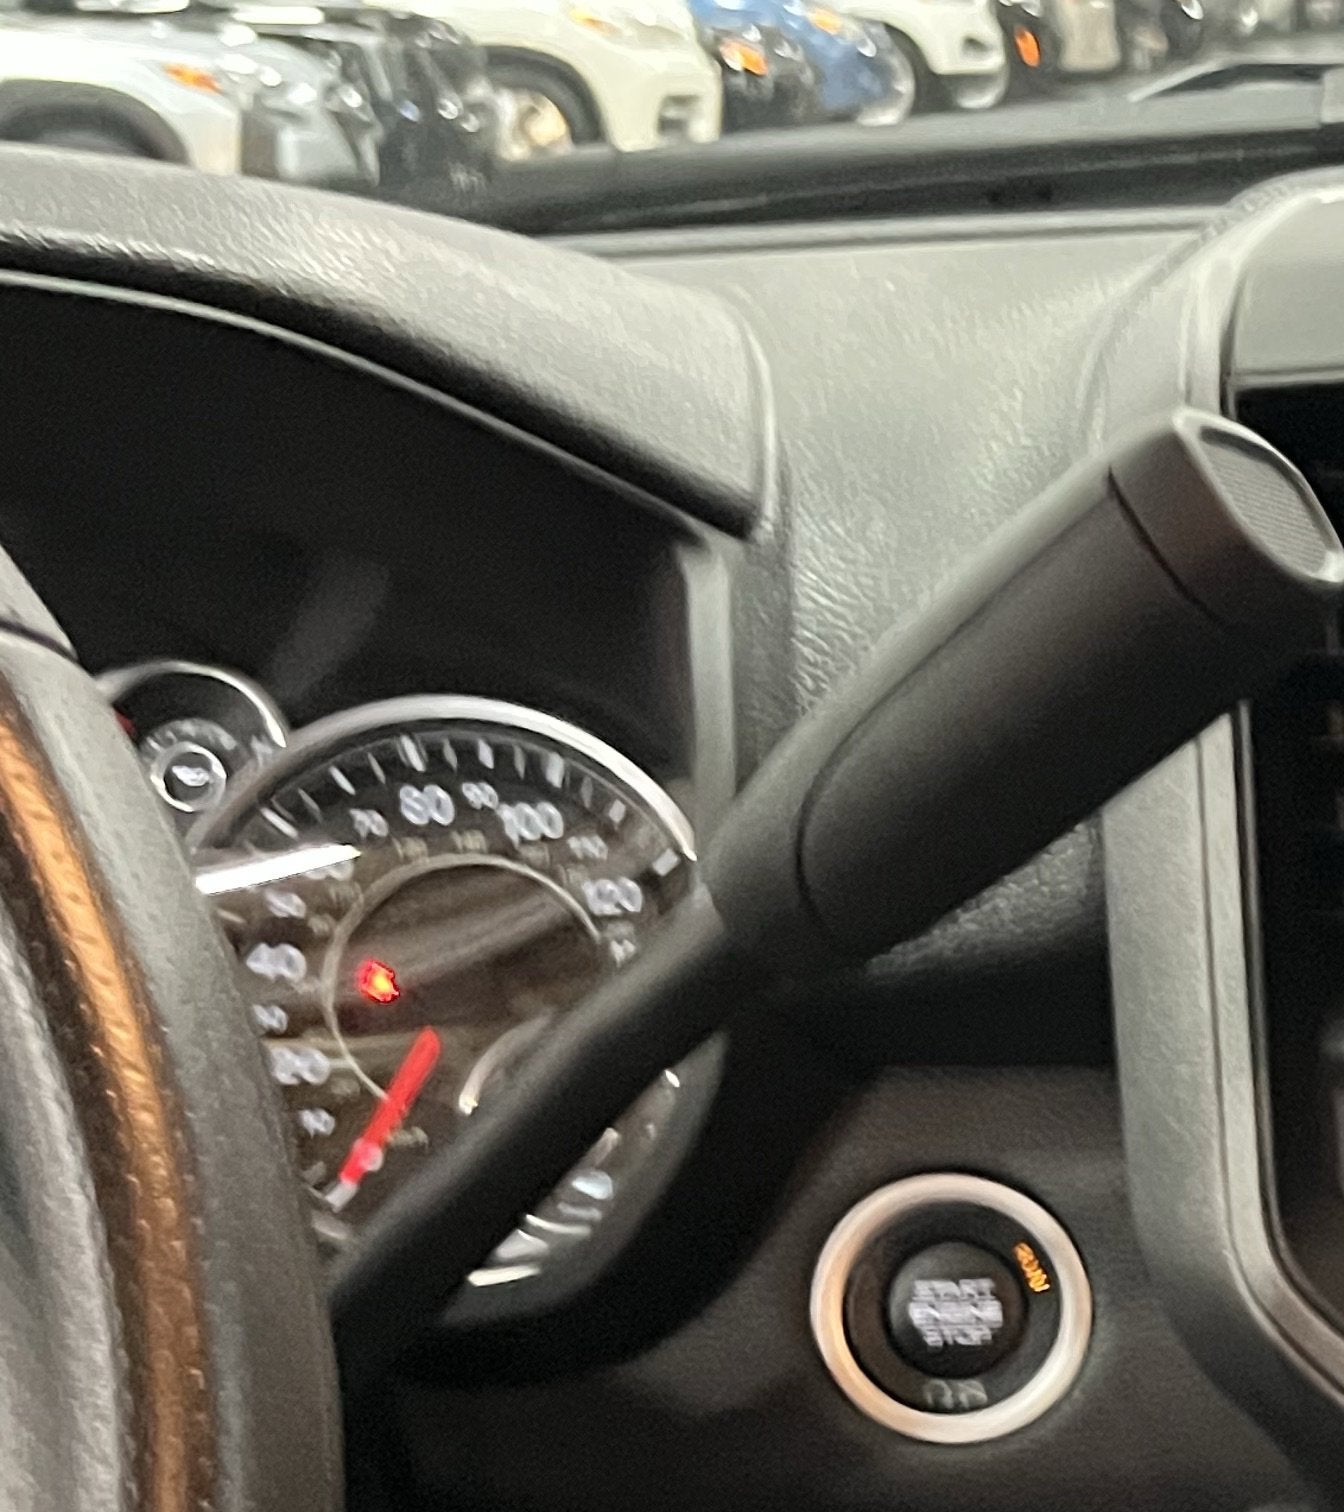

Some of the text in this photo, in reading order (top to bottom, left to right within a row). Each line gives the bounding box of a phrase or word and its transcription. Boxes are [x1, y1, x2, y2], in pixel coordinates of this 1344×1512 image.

[400, 784, 455, 826] 80
[500, 801, 564, 848] 100
[581, 876, 644, 917] 120
